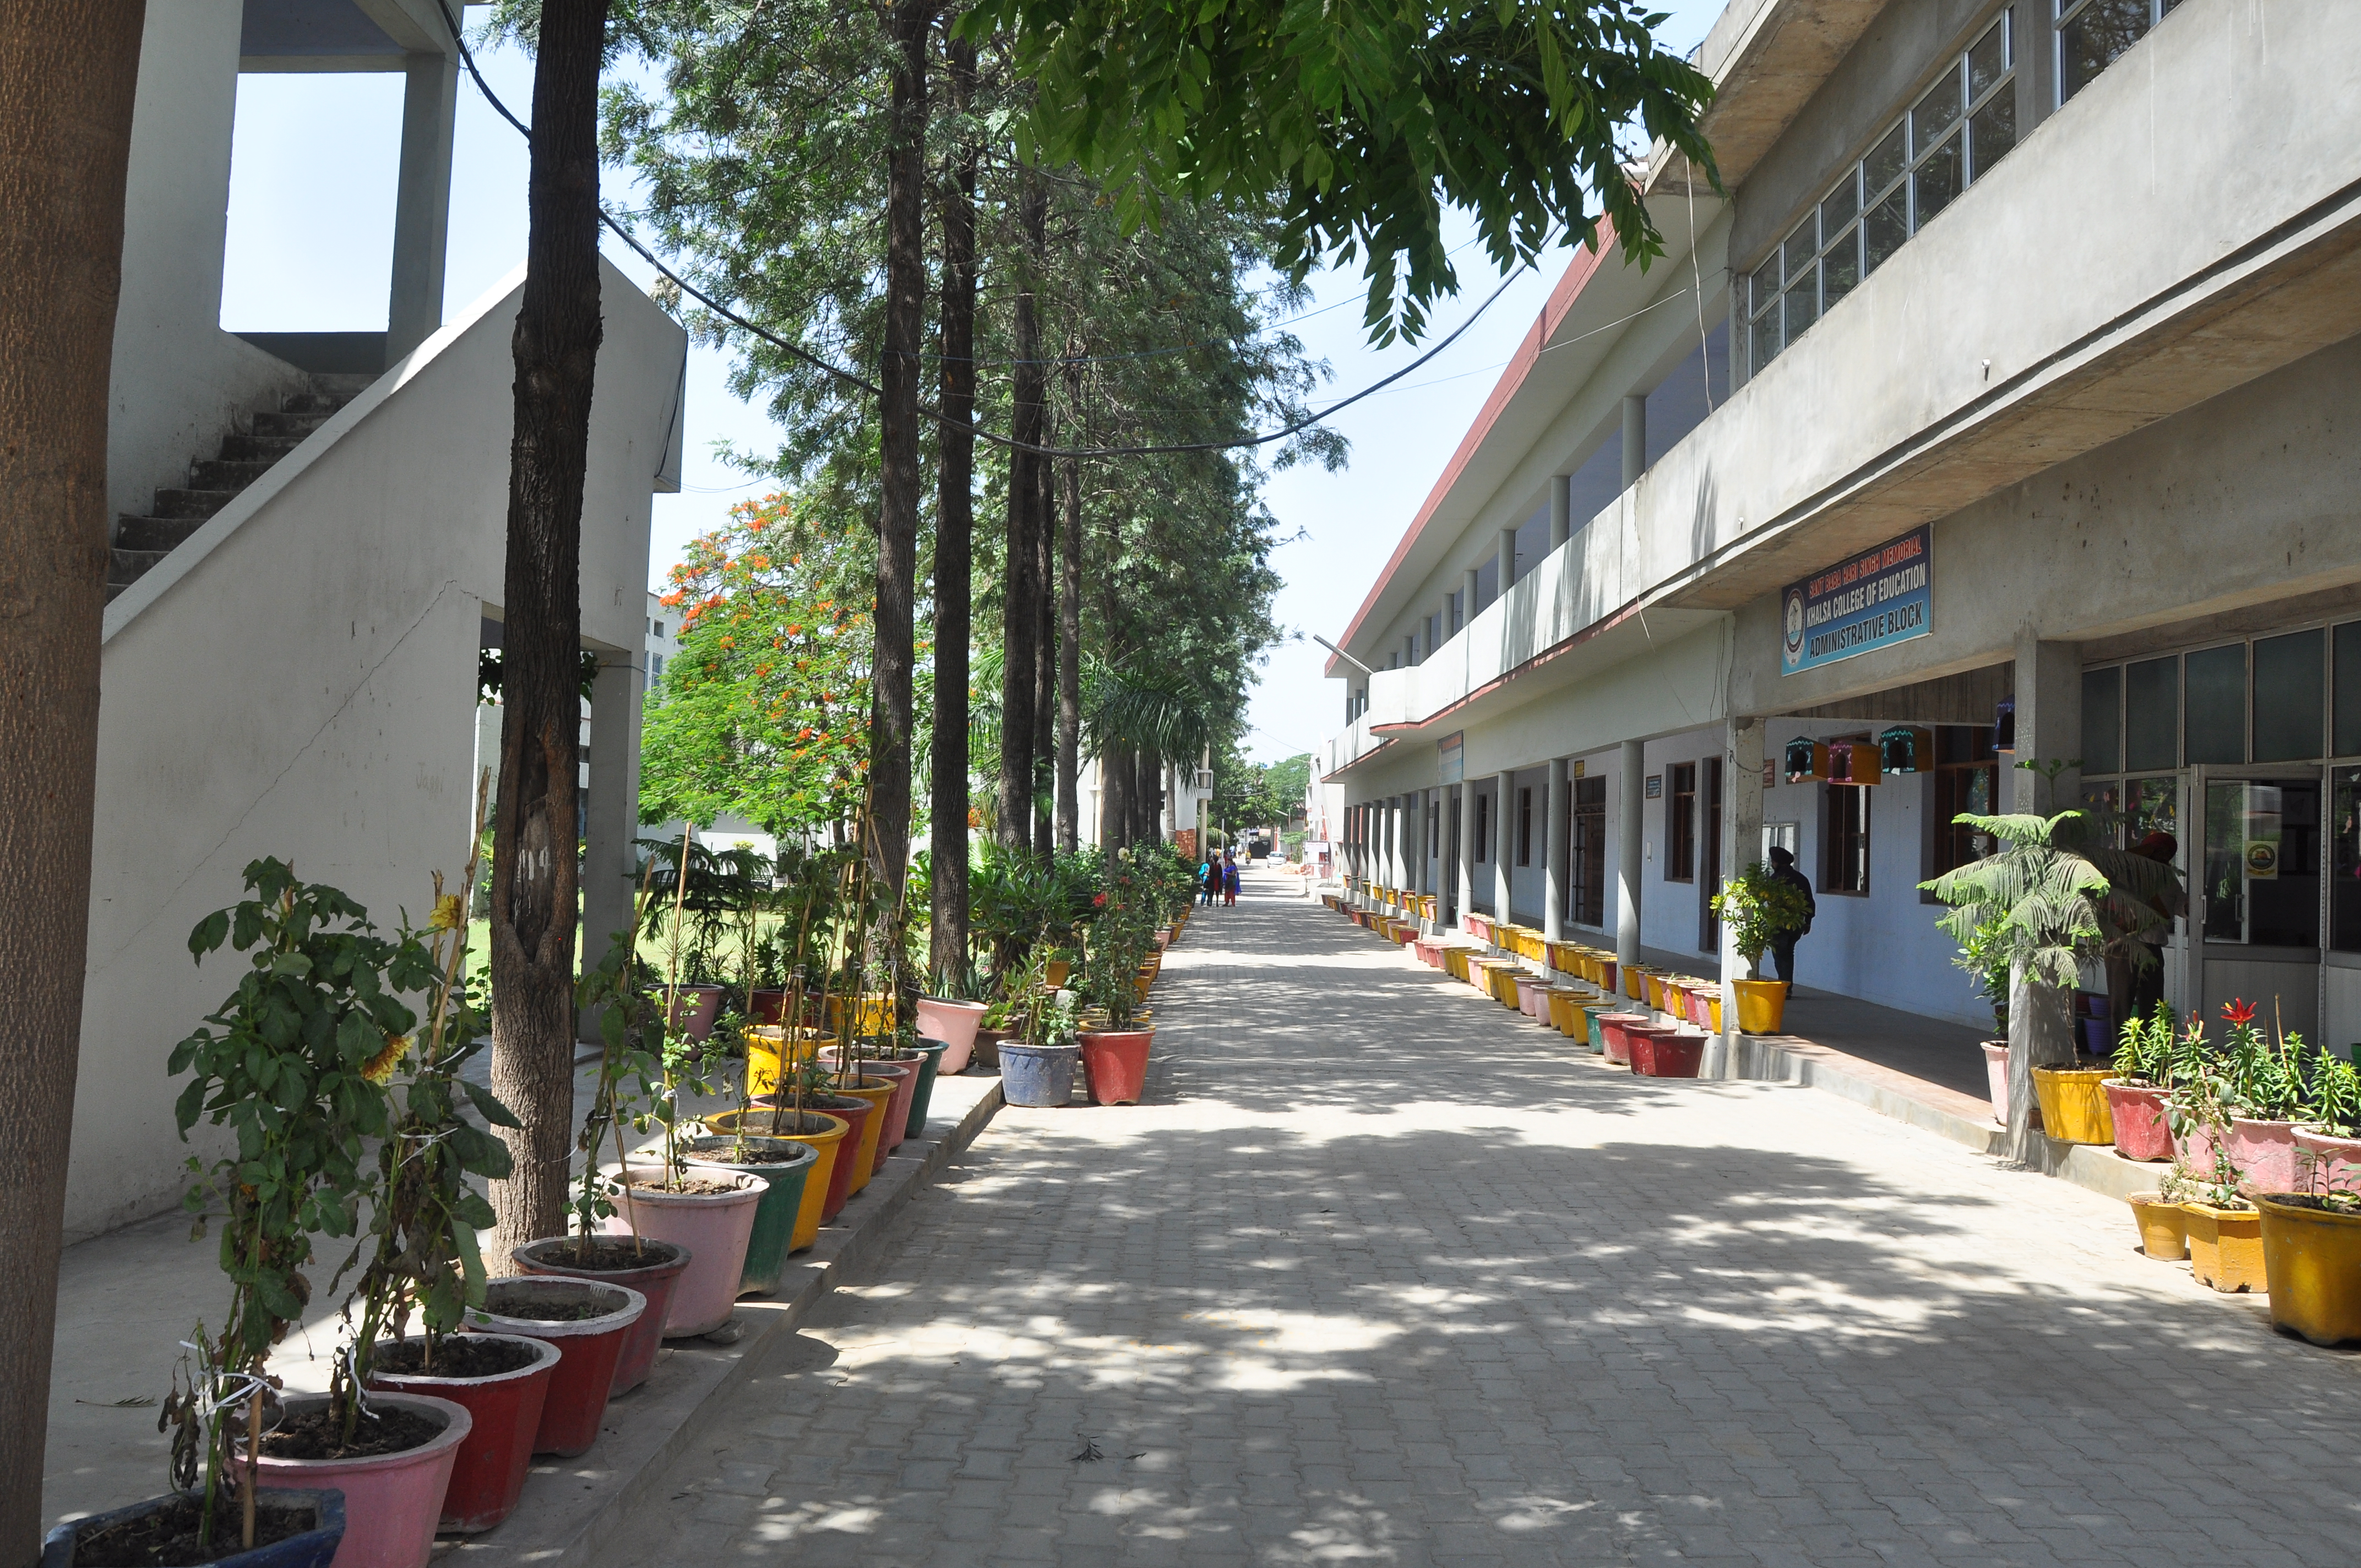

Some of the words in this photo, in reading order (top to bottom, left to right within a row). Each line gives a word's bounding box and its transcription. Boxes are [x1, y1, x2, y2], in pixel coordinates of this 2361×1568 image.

[1807, 600, 1831, 628] KHALSA
[1833, 586, 1864, 619] COLLEGE
[1866, 581, 1876, 607] OF
[1879, 563, 1925, 603] EDUCATION
[1809, 576, 1824, 598] SANT
[1825, 570, 1841, 592] BABA
[1843, 562, 1858, 585] HARI
[1859, 553, 1880, 578] SINGH
[1882, 535, 1922, 569] MEMORIAL
[1809, 614, 1885, 659] ADMINISTRATIVE
[1887, 601, 1923, 634] BLOCK
